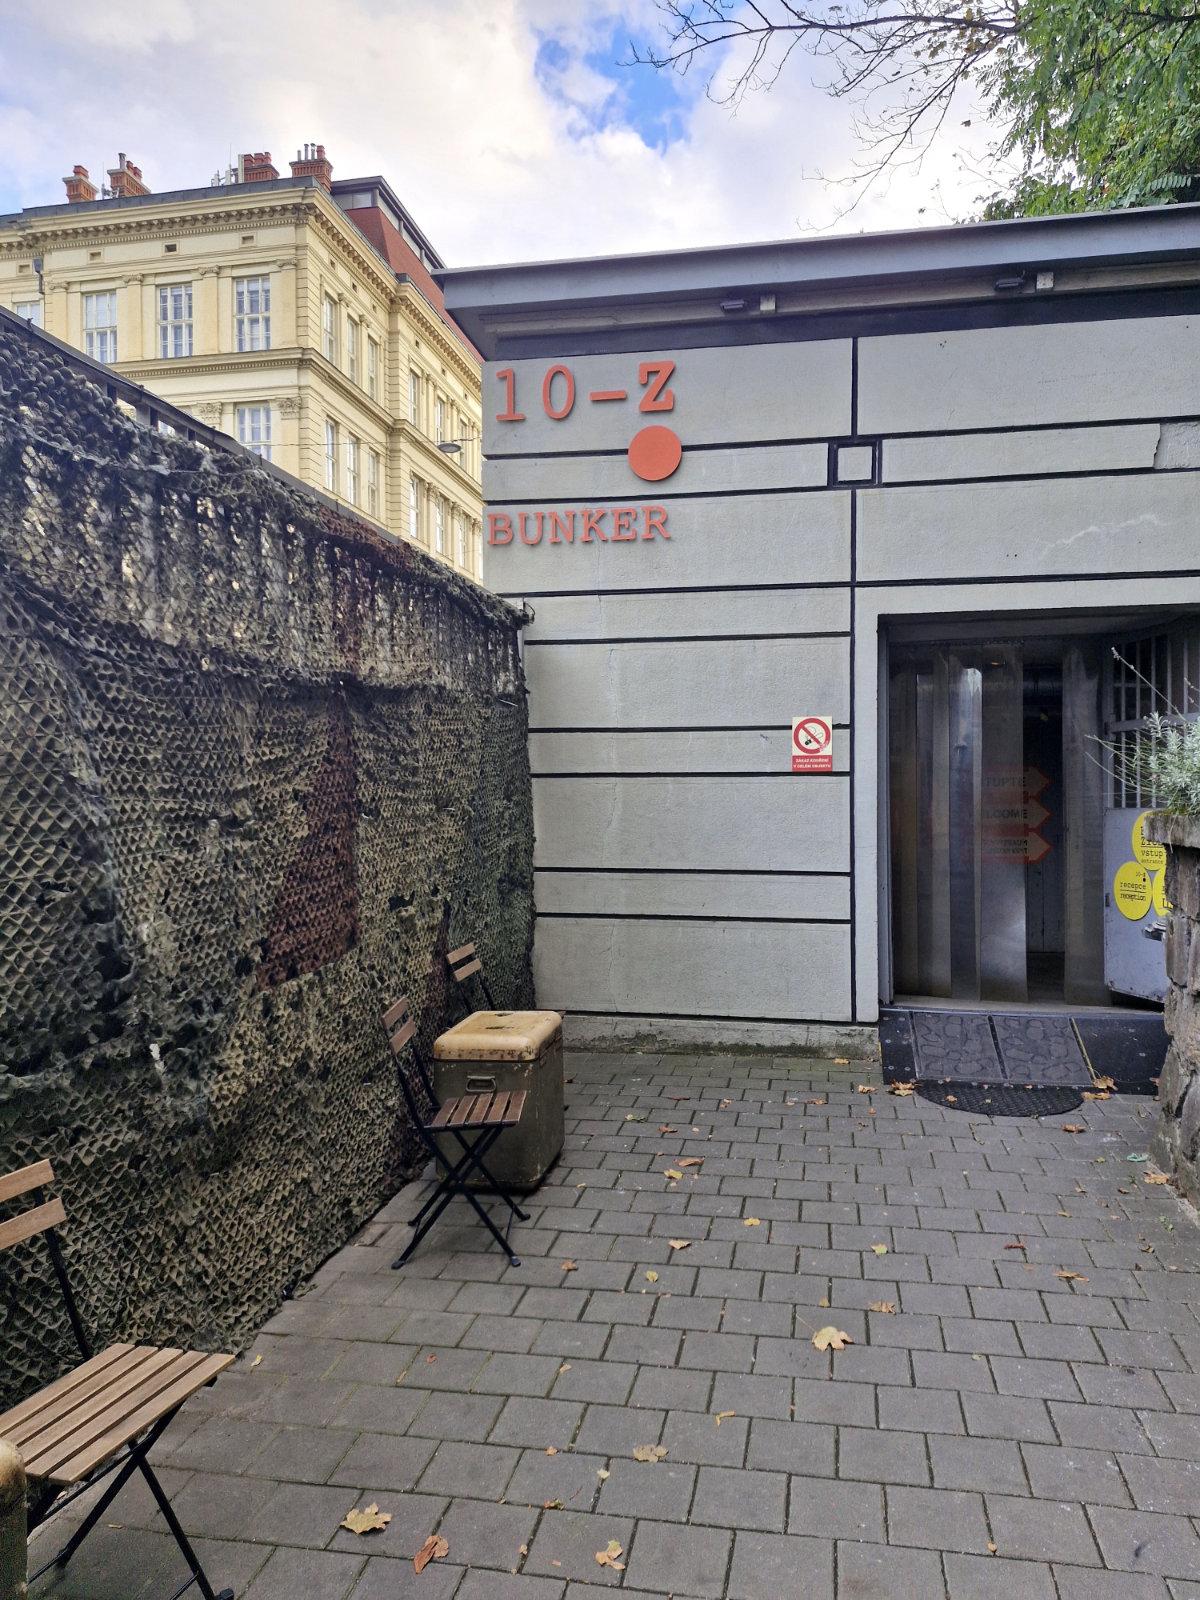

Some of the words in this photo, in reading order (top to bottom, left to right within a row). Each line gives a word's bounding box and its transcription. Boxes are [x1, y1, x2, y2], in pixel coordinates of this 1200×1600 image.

[487, 505, 671, 545] BUNKER
[1141, 850, 1163, 860] vstup
[1120, 882, 1146, 890] recepce
[1120, 893, 1146, 902] reception
